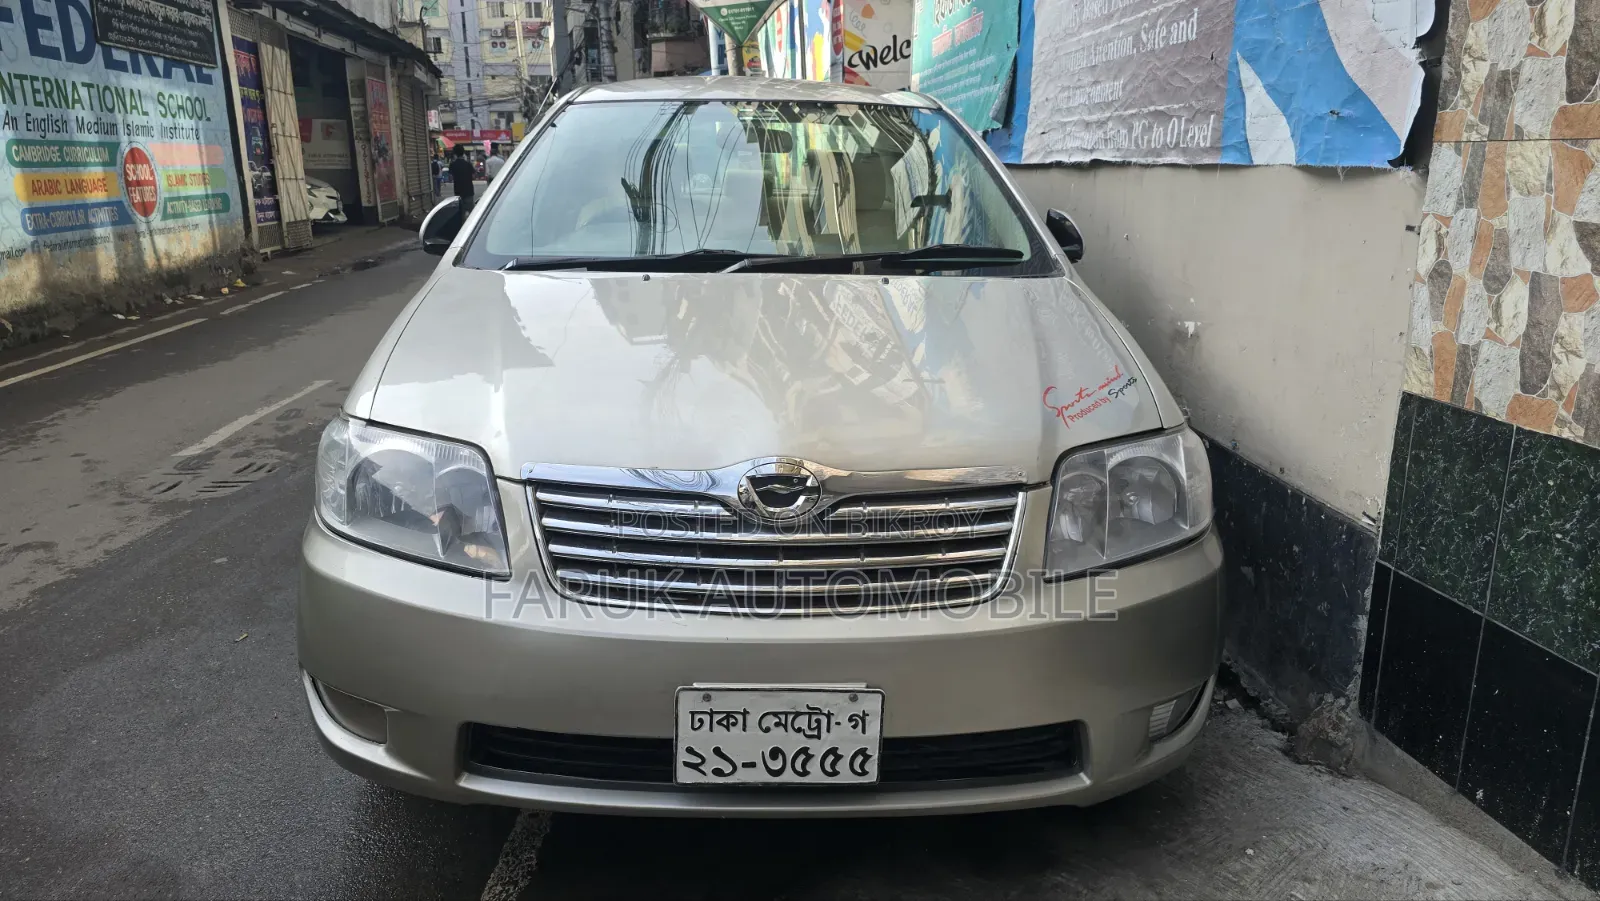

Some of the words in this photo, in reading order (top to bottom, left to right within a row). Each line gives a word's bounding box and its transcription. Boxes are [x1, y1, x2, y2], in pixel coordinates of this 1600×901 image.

[1141, 18, 1167, 52] Safe
[1169, 8, 1199, 46] and
[157, 91, 211, 122] SCHOOL
[3, 111, 19, 131] An
[26, 113, 68, 139] English
[76, 116, 118, 137] Medium
[123, 120, 154, 138] Islamic
[161, 124, 200, 141] Institute
[1131, 119, 1148, 149] PG
[1151, 120, 1164, 149] to
[1167, 117, 1178, 149] O
[1180, 114, 1216, 148] Level
[12, 145, 62, 162] CAMBRIDGE
[63, 146, 109, 163] CURRICULUM
[126, 163, 154, 181] SCHOOL
[166, 173, 187, 188] ISLAMIC
[31, 179, 62, 197] ARABIC
[65, 177, 109, 196] LANGUAGE
[128, 186, 156, 204] FEATURES
[1067, 400, 1101, 422] Produced
[1101, 396, 1113, 406] by
[1107, 376, 1138, 399] Sports
[688, 708, 750, 733] ঢাকা
[682, 745, 874, 778] ২১-৩৫৫৫
